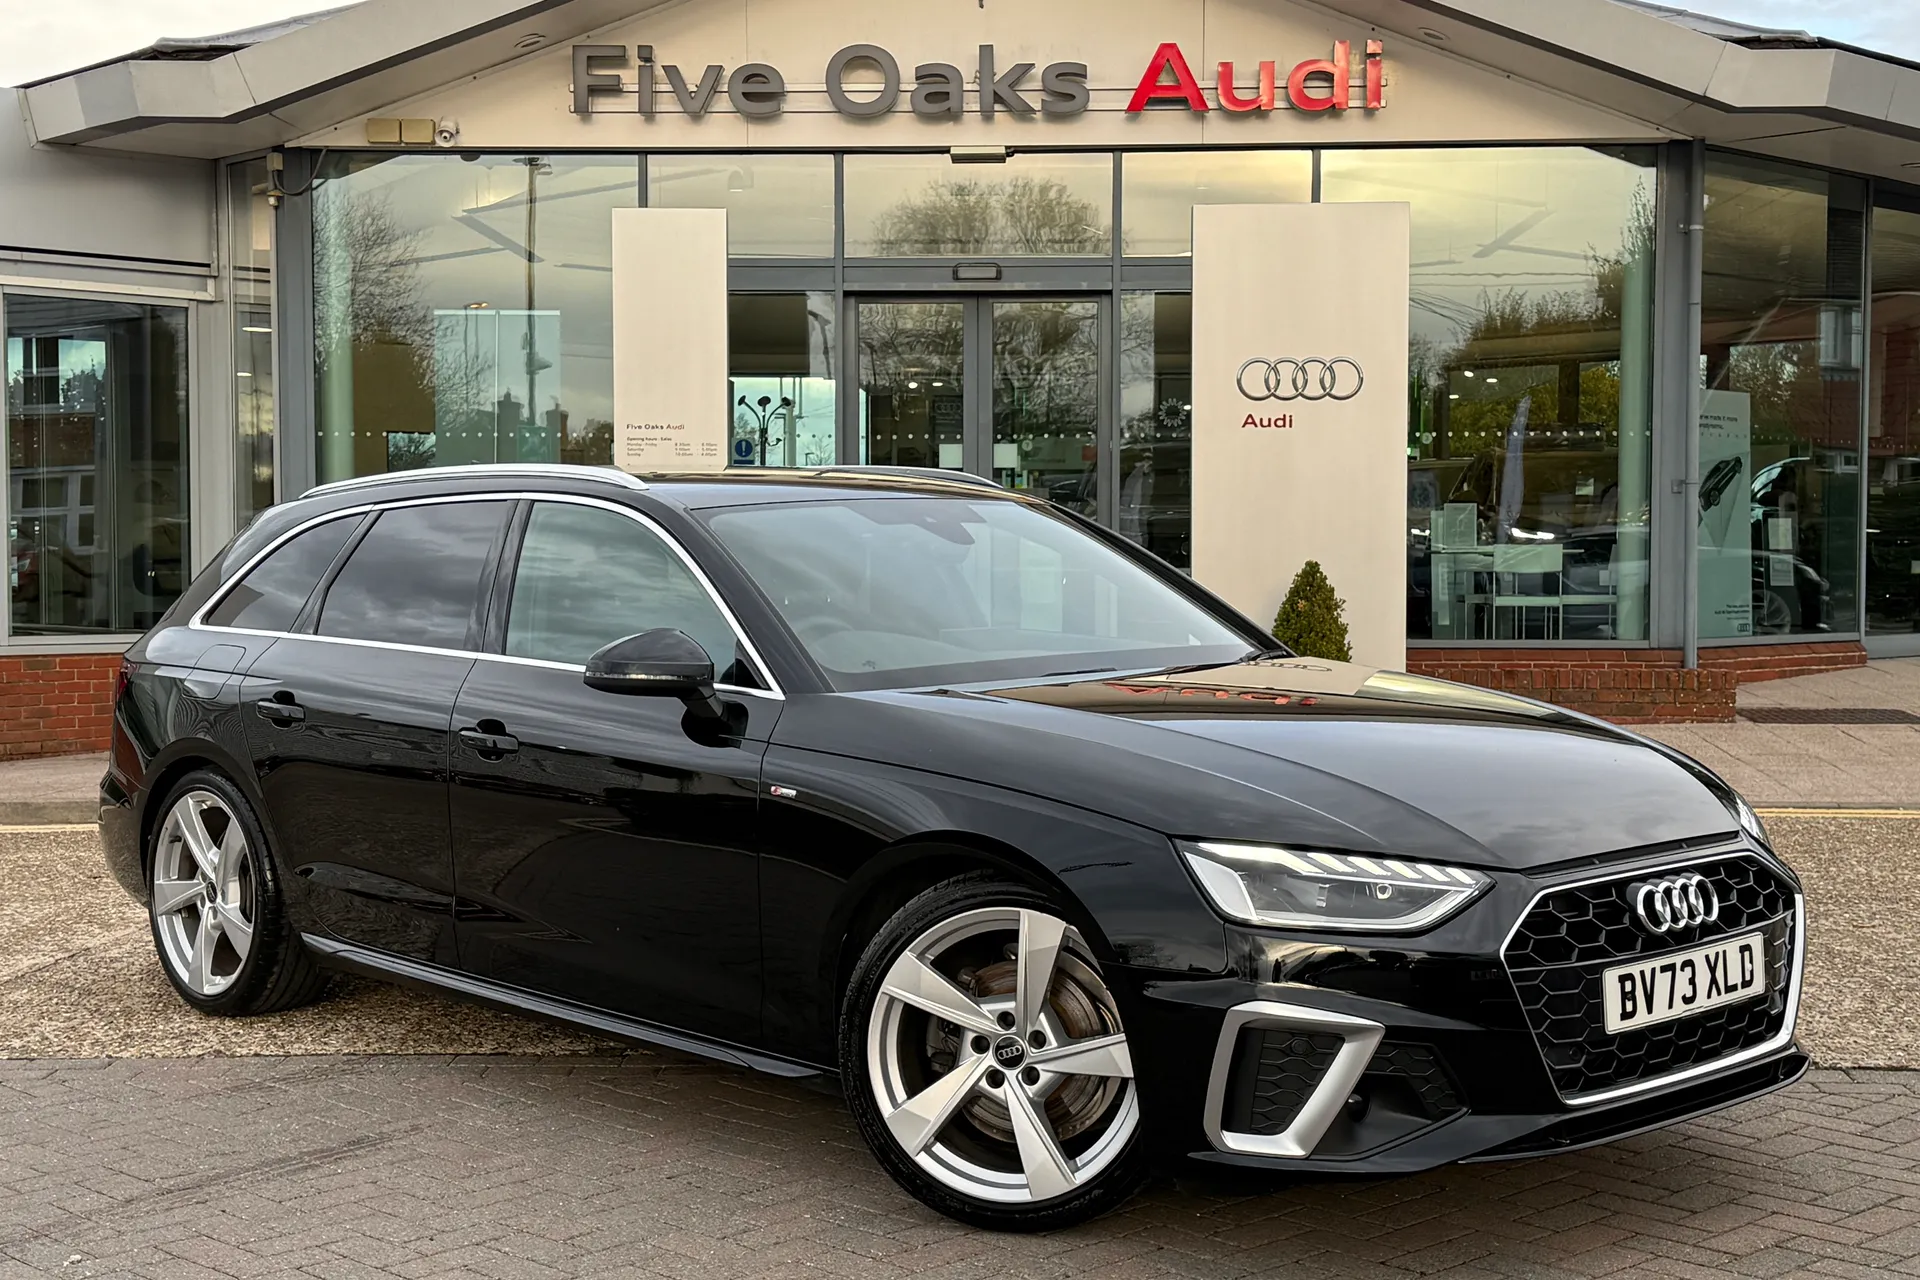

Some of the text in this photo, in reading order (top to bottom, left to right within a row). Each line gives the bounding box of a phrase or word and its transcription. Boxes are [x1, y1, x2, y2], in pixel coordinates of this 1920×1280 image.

[572, 39, 1383, 117] Five Oaks Audi
[1241, 413, 1293, 428] Audi
[1617, 943, 1755, 1022] BV73 XLD
